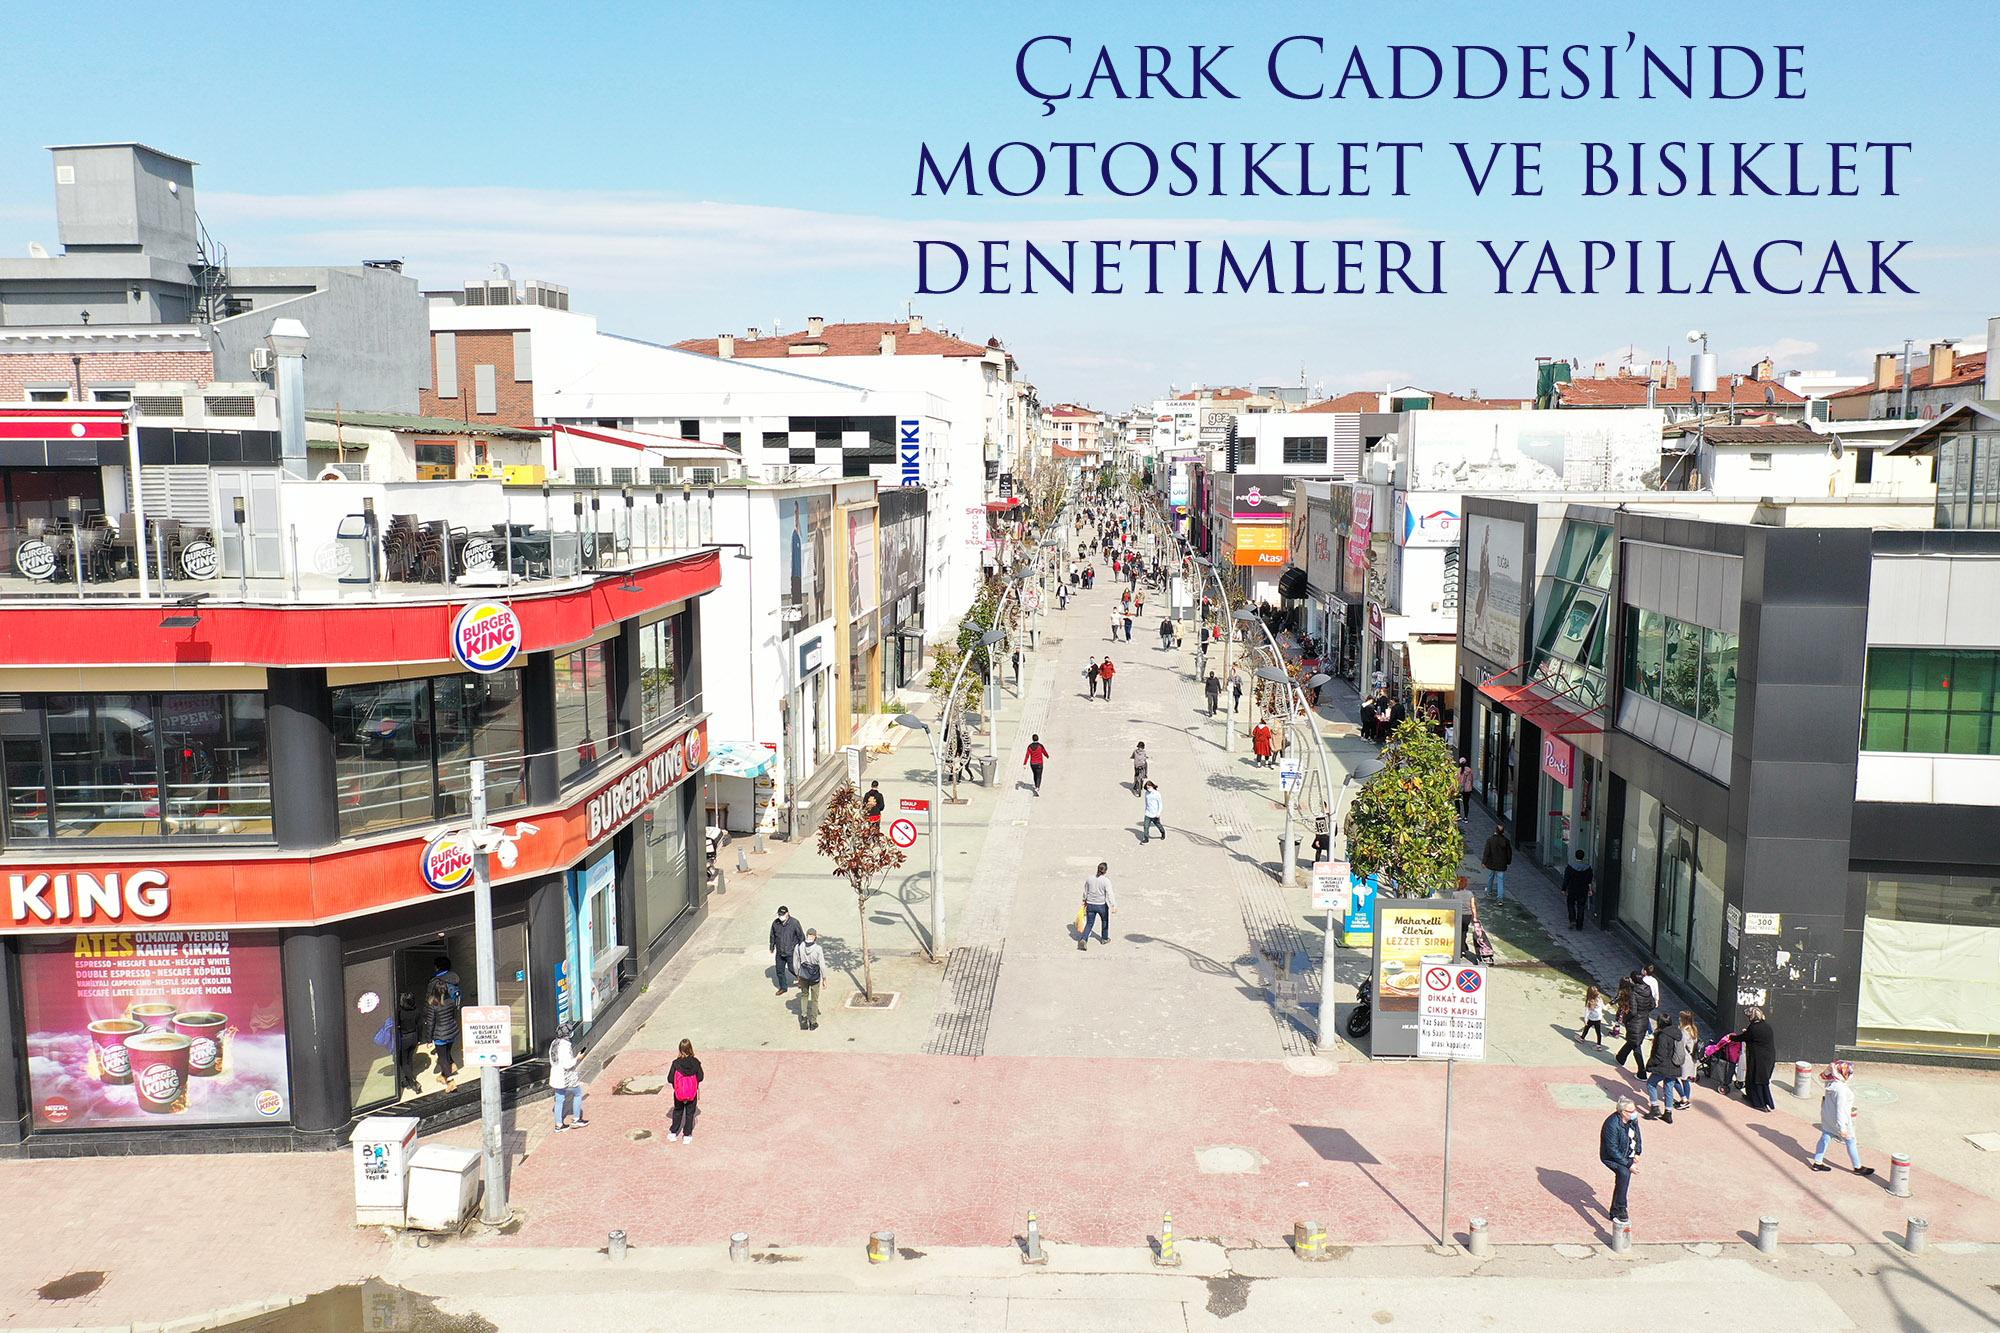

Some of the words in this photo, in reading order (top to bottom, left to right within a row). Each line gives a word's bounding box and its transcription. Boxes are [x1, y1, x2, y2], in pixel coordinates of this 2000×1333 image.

[21, 546, 52, 560] BURGER
[186, 547, 217, 562] BURGER
[466, 542, 492, 559] BURGER
[466, 549, 494, 567] KING
[22, 553, 55, 570] KING
[187, 554, 218, 571] KING
[463, 613, 512, 642] BURGER
[465, 624, 515, 661] KING
[1544, 740, 1568, 776] Penti
[586, 766, 649, 841] BURGER
[648, 742, 683, 794] KING
[433, 853, 472, 880] KING
[9, 869, 170, 920] KING
[136, 931, 184, 942] OLMAYAN
[187, 931, 229, 941] YERDEN
[1401, 926, 1433, 936] Ellerin
[136, 943, 178, 956] KAHVE
[1386, 937, 1421, 946] LEZZET
[1425, 938, 1449, 947] SIRRI
[75, 960, 112, 968] ESPRESSO
[149, 959, 171, 967] BLACK
[207, 957, 230, 965] WHITE
[76, 970, 108, 979] DOUBLE
[110, 969, 150, 978] ESPRESSO
[112, 988, 134, 997] LATTE
[205, 986, 232, 995] MOCHA
[143, 1069, 177, 1085] BURGER
[145, 1076, 180, 1096] KING
[260, 1099, 280, 1110] KING
